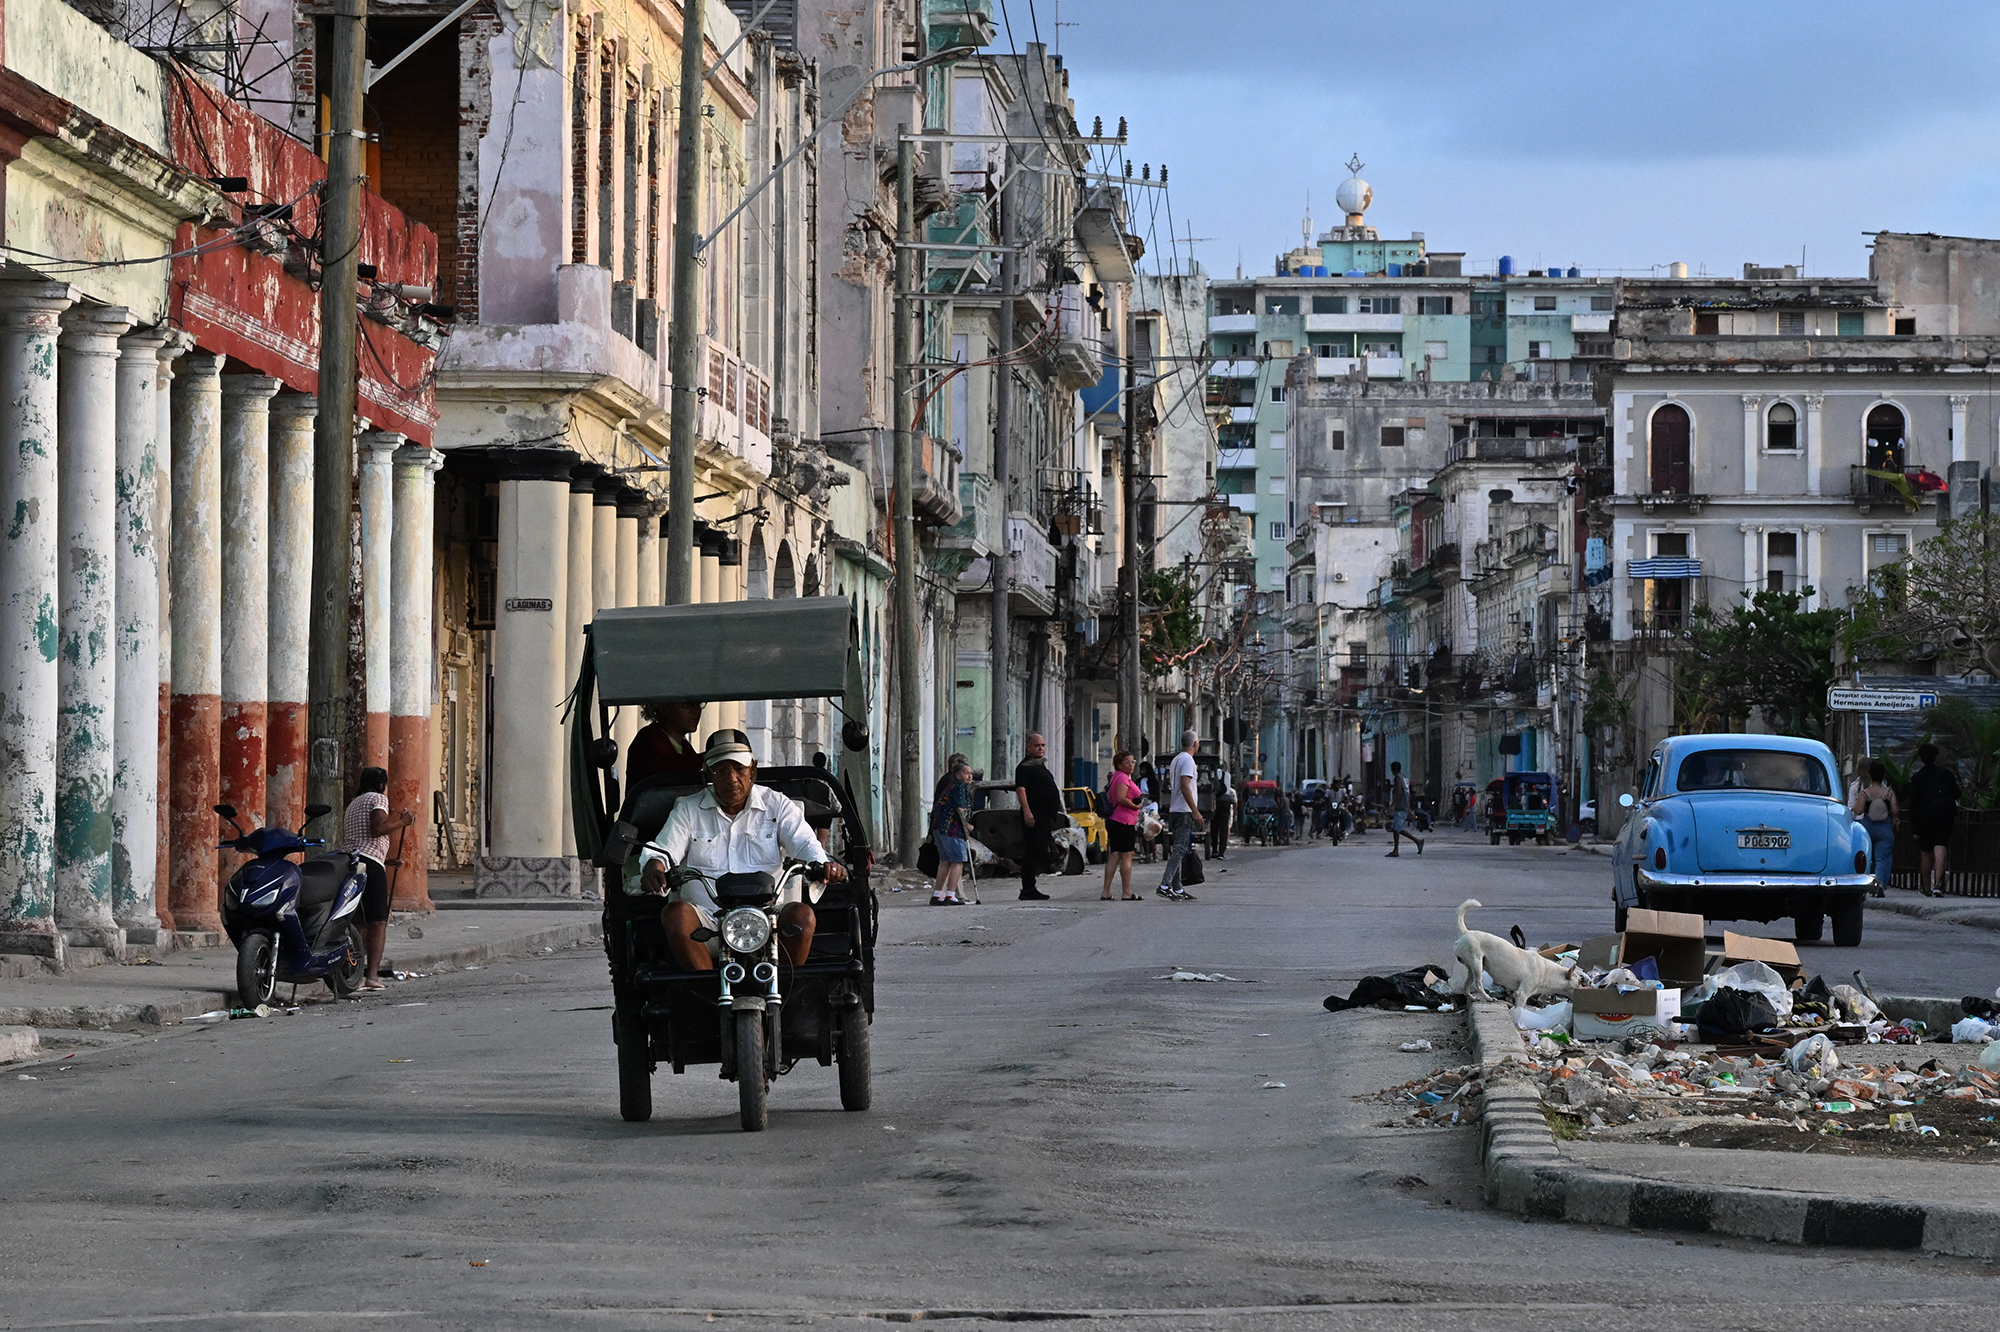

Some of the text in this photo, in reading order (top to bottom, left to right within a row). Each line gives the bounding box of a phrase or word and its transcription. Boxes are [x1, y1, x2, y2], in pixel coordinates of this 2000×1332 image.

[512, 601, 547, 609] LAGUNAS
[1833, 699, 1915, 709] Hermanos Ameijeiras
